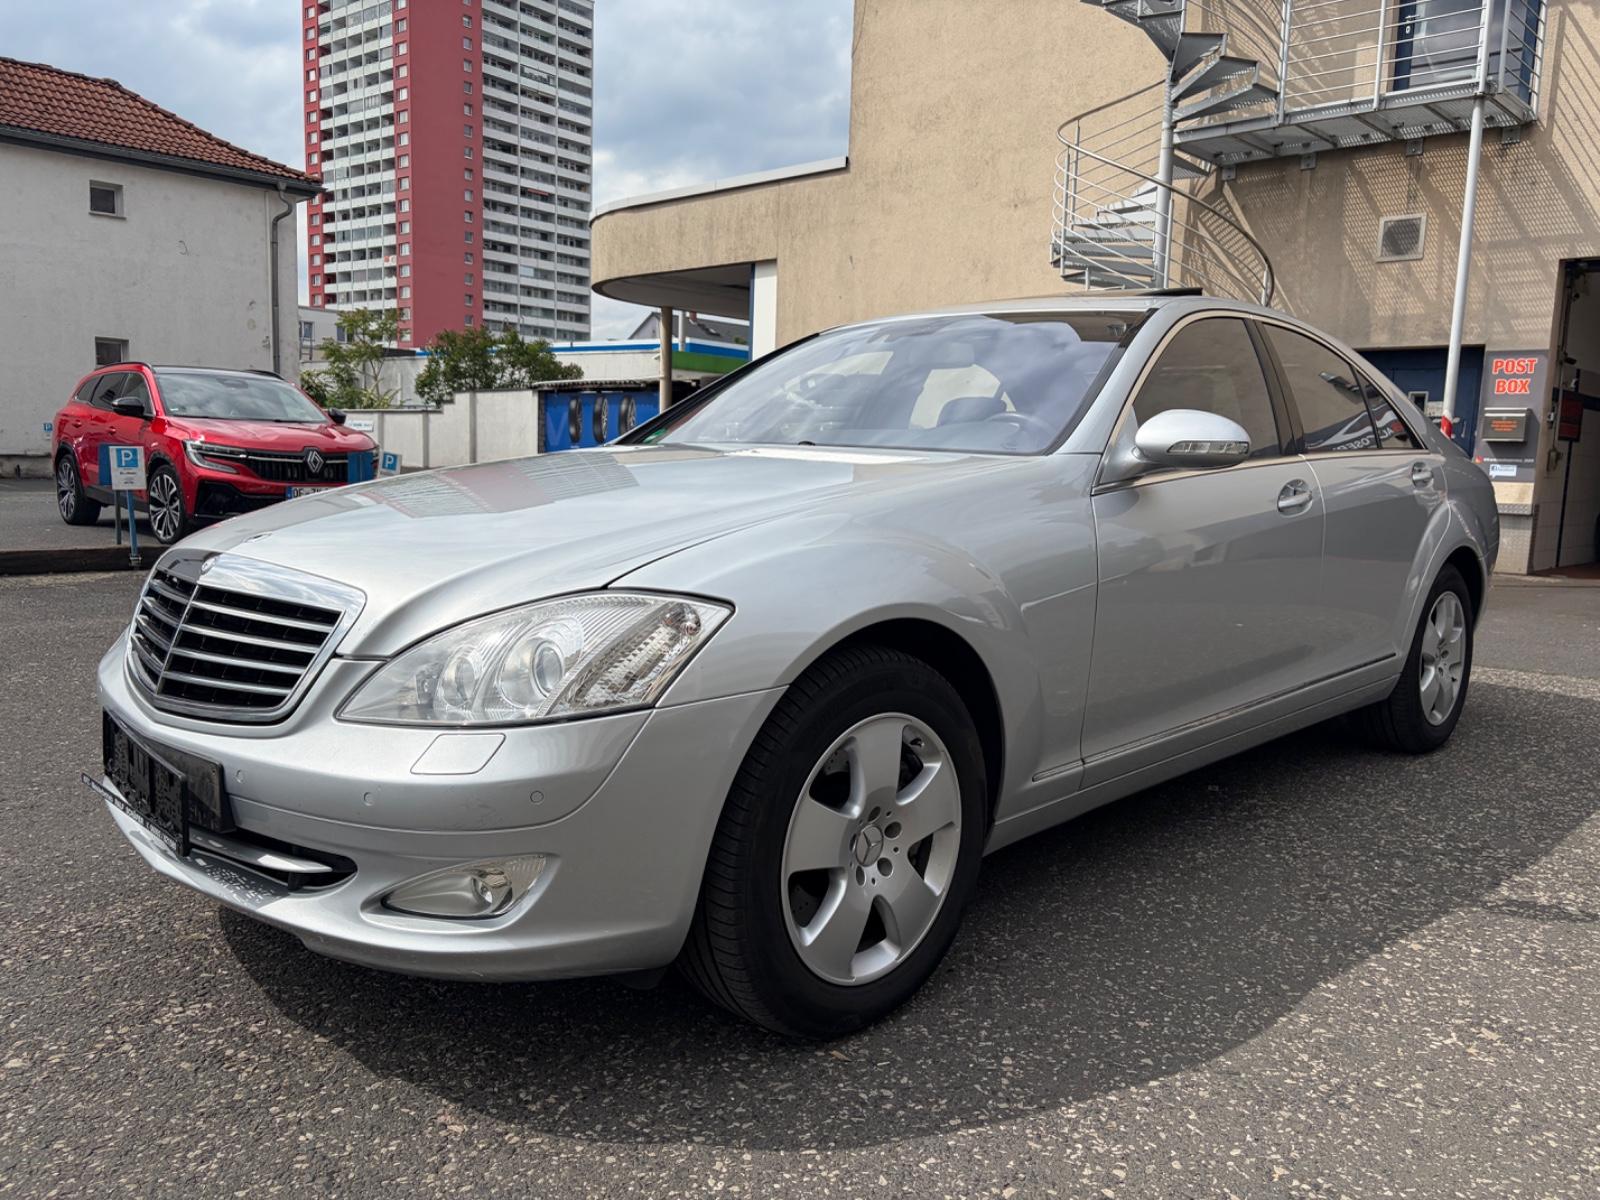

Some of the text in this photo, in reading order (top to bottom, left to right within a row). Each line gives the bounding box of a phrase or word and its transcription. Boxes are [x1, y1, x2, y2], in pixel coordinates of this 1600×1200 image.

[1492, 358, 1538, 375] POST
[1495, 378, 1531, 394] BOX
[121, 450, 133, 467] P
[385, 454, 394, 469] P
